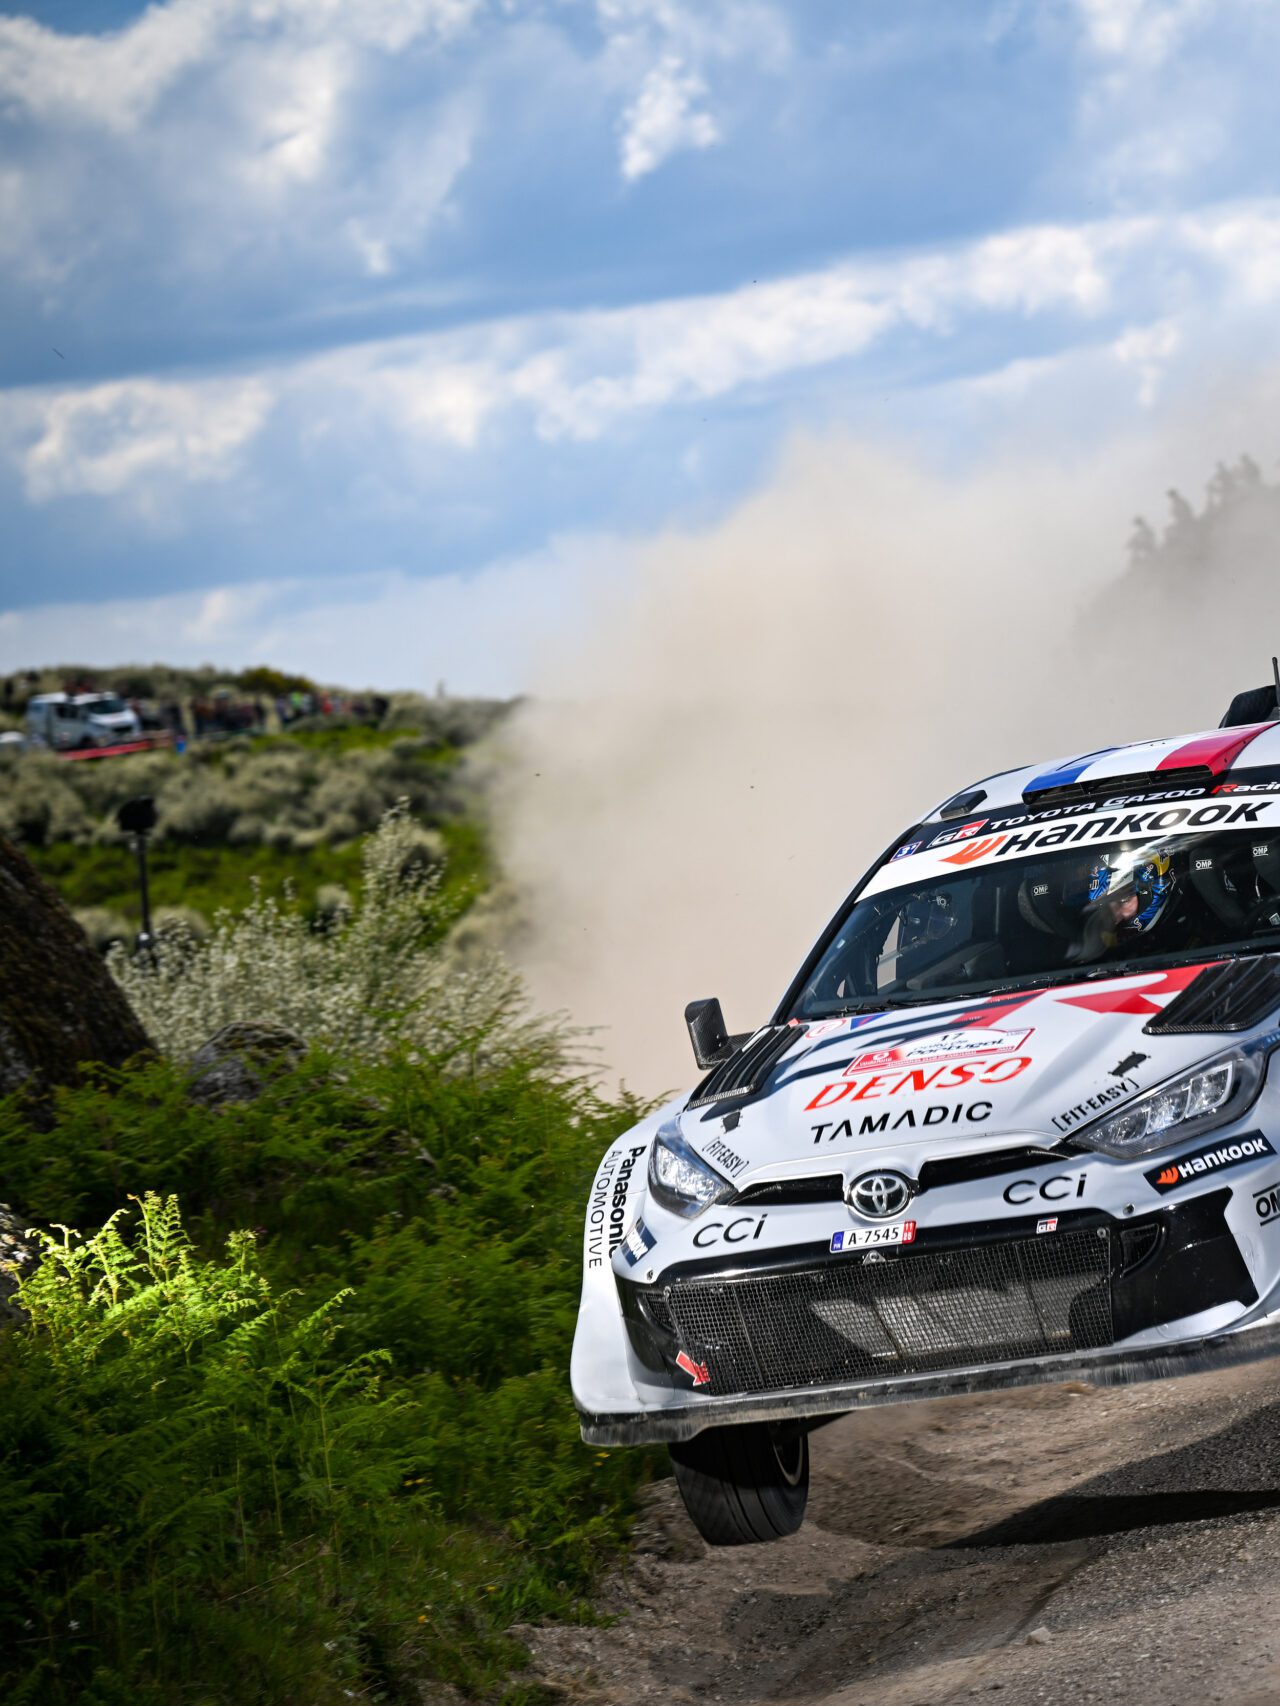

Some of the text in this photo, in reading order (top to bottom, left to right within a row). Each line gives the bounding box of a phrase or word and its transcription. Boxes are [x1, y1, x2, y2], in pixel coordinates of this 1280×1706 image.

[930, 824, 981, 847] GR
[989, 802, 1096, 830] TOYOTA
[1103, 787, 1206, 807] GAZOO
[1196, 859, 1212, 870] OMP
[1253, 845, 1269, 857] OMP
[1033, 885, 1048, 896] OMP
[804, 1057, 1032, 1111] DENSO
[811, 1102, 993, 1144] TAMADIC
[589, 1150, 622, 1269] AUTOMOTIVE
[848, 1227, 899, 1245] A-7545
